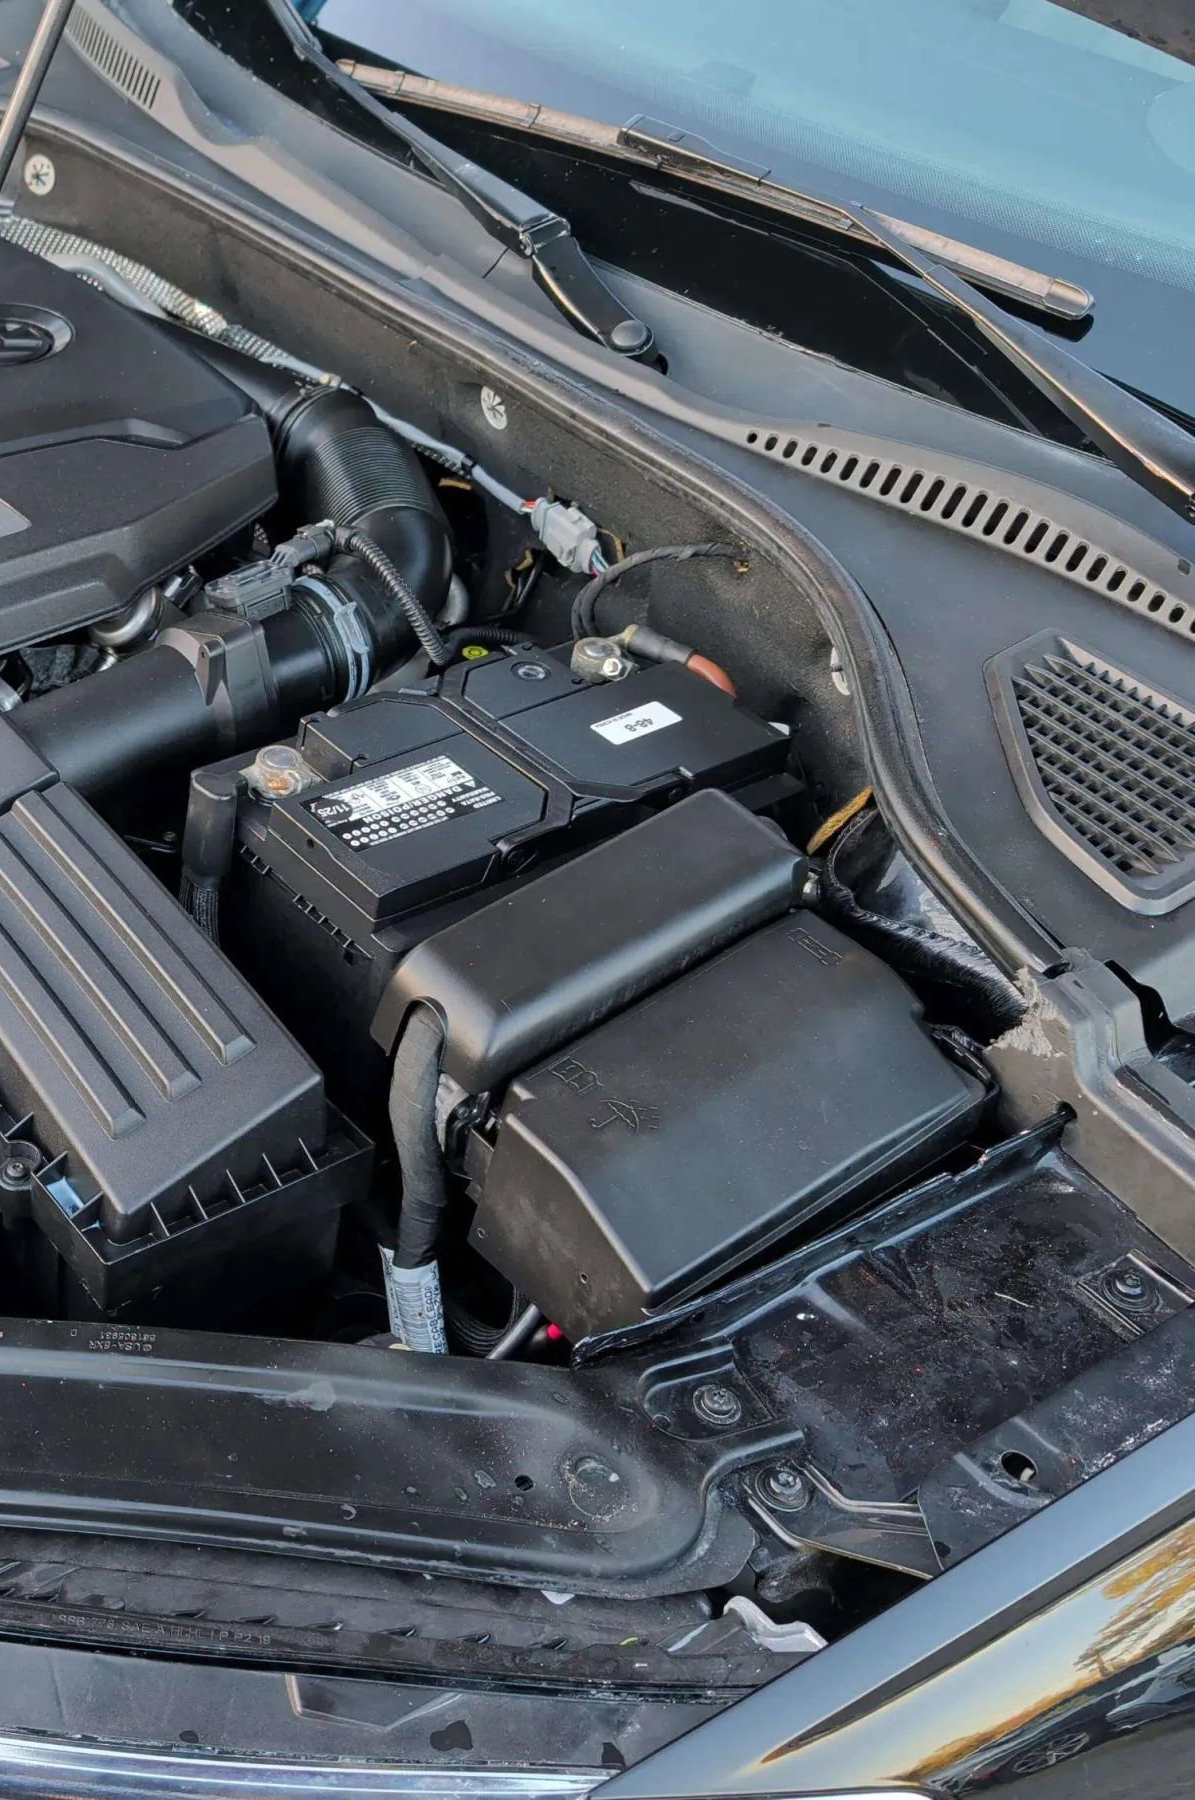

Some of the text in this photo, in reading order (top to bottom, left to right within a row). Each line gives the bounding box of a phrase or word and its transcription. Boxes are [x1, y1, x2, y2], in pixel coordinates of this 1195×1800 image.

[624, 718, 654, 732] 48-8
[317, 804, 351, 818] 11/25
[362, 786, 463, 824] DANGER/POISON
[121, 1621, 151, 1634] SAE
